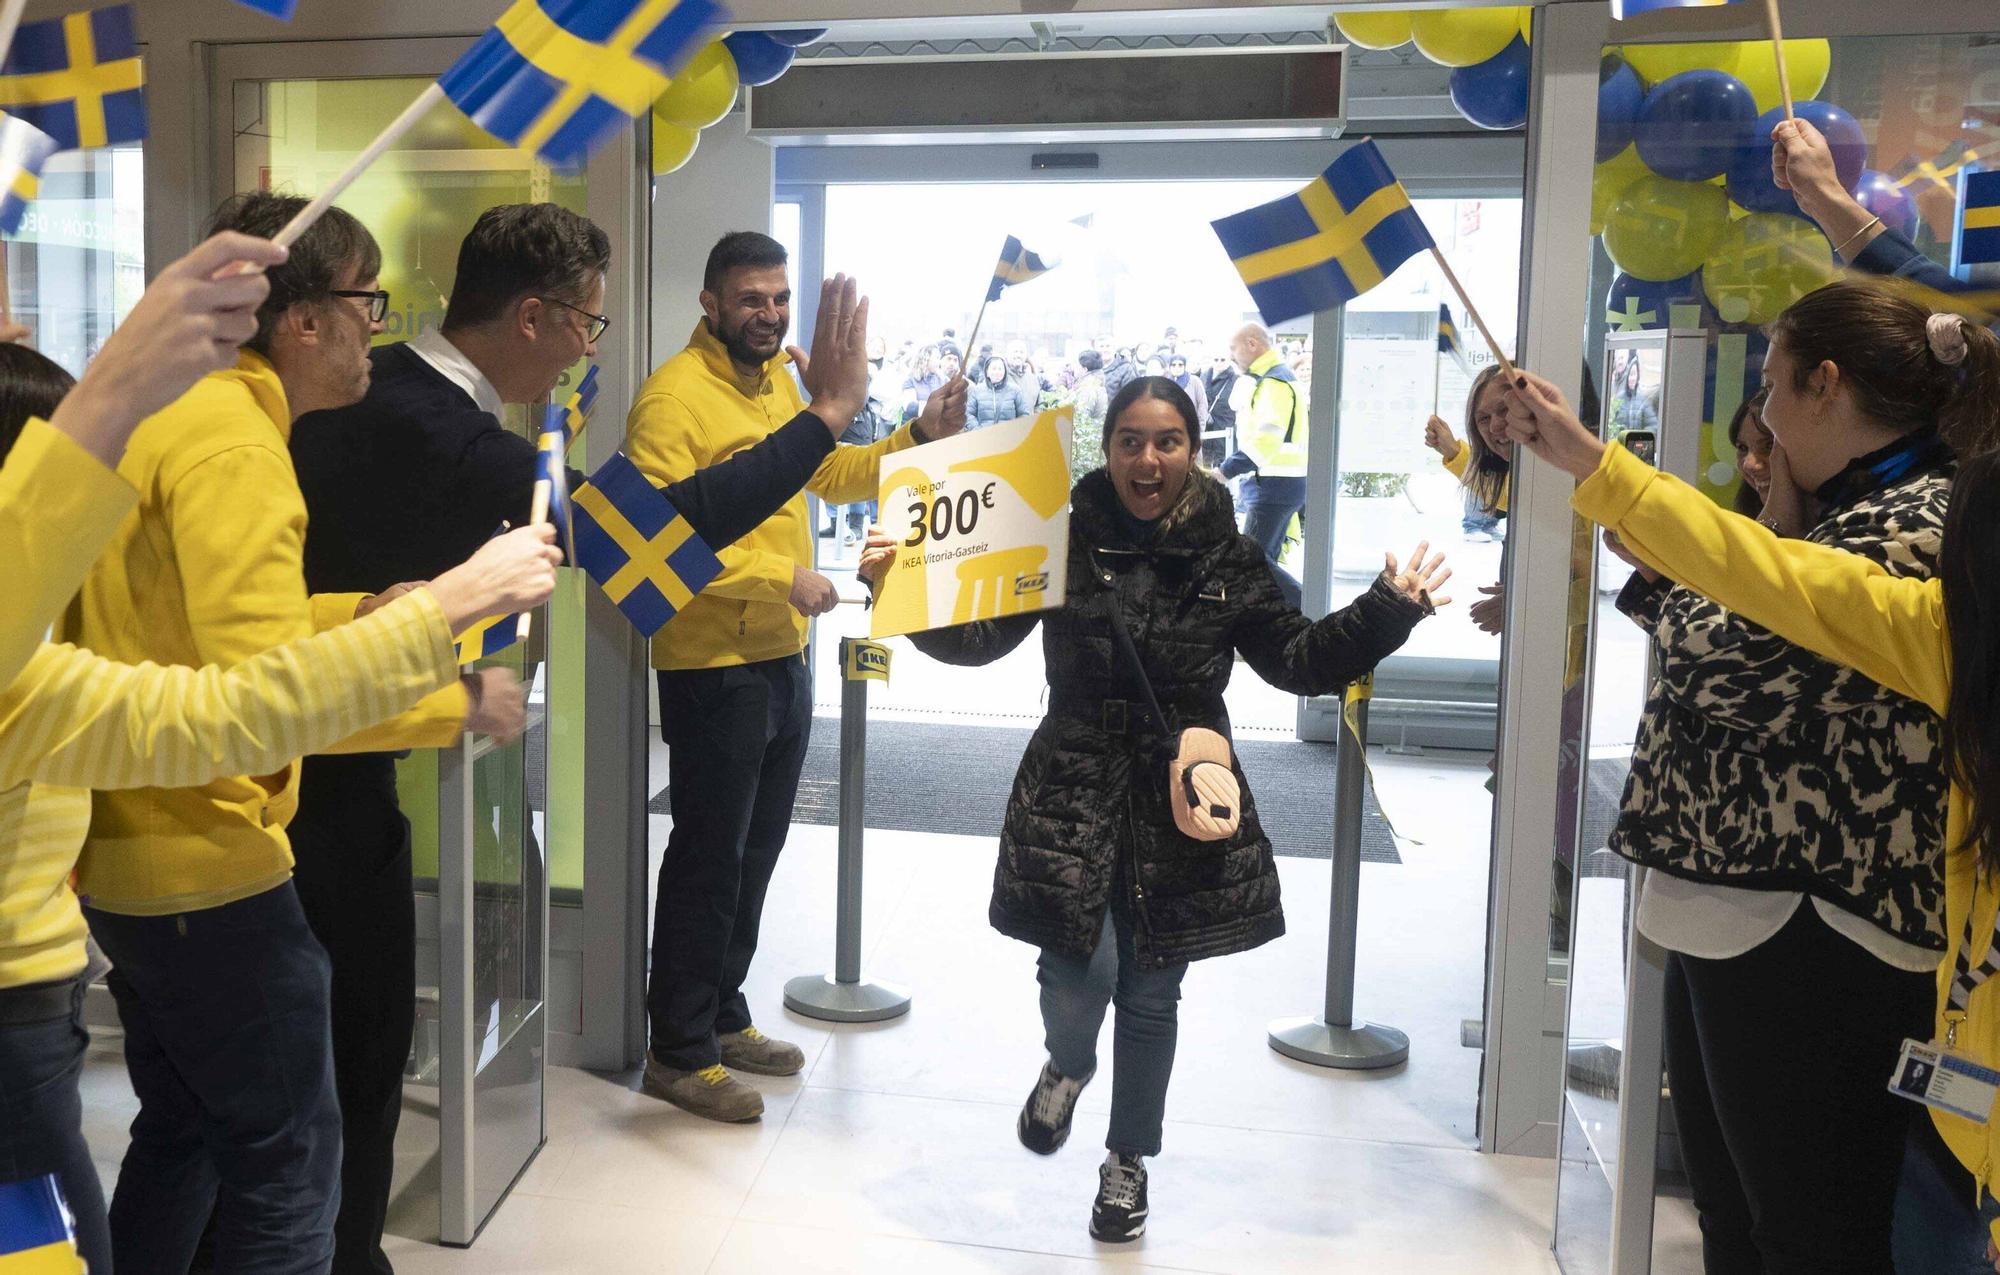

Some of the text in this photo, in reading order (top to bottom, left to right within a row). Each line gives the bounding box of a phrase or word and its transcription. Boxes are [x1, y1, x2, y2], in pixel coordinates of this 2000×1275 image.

[906, 480, 946, 498] Vale por
[904, 482, 996, 547] 300€
[902, 541, 989, 570] IKEA Vitoria-Gasteiz
[1017, 575, 1046, 592] IKEA
